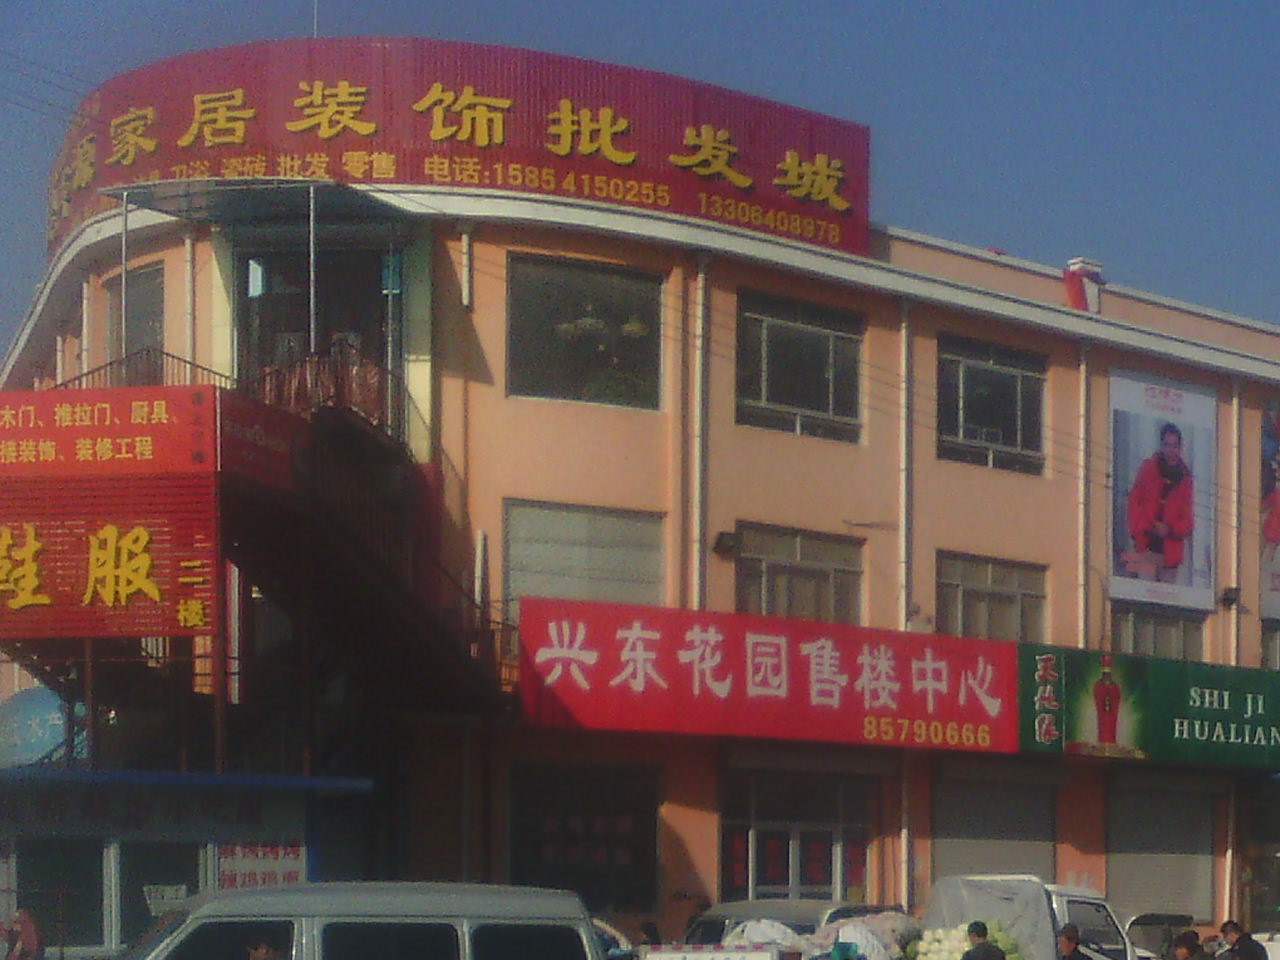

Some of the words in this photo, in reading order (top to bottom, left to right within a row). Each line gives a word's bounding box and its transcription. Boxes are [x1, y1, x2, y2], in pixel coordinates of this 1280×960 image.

[276, 152, 330, 179] 批发
[342, 150, 398, 180] 零售
[535, 620, 1002, 718] 兴东花园售楼中心
[1188, 686, 1231, 711] SHI
[1243, 692, 1265, 719] JI
[863, 715, 992, 748] 85790666
